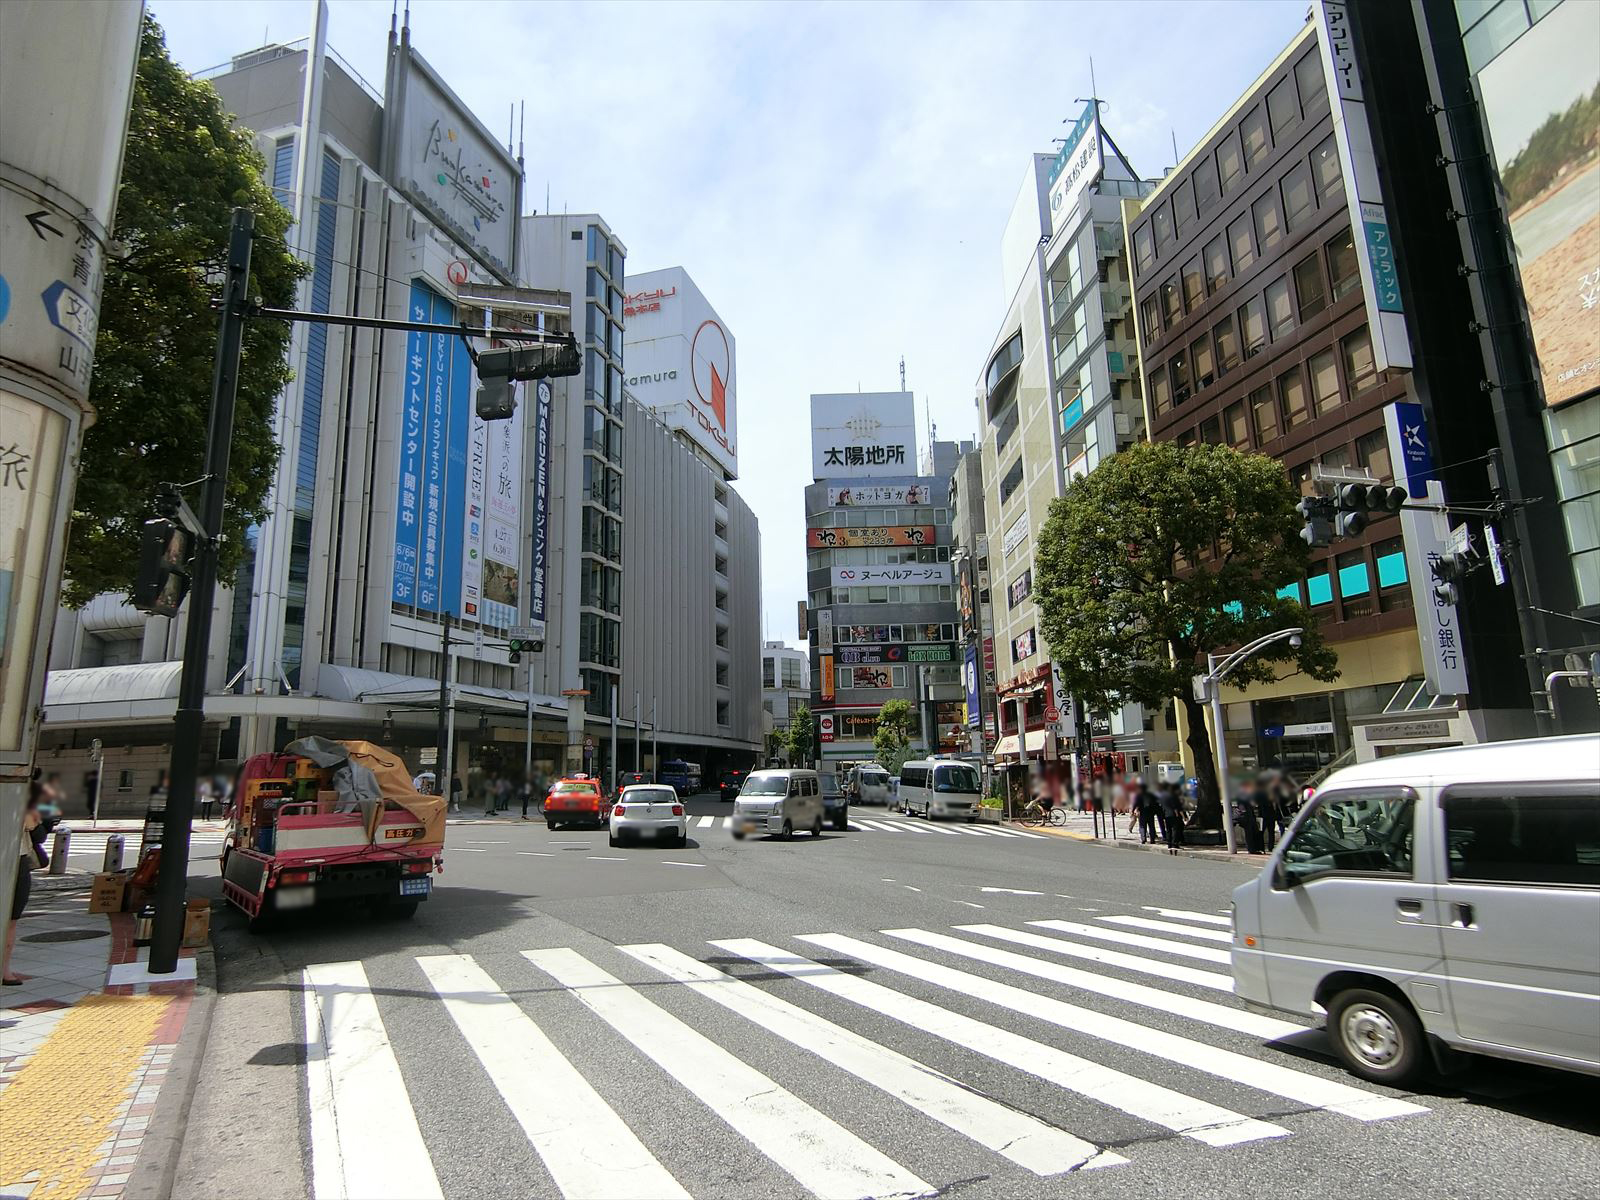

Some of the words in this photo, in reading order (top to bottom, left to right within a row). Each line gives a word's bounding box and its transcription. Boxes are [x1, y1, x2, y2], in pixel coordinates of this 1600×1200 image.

[1374, 230, 1396, 304] アフラック
[436, 328, 445, 372] OKYU
[688, 400, 735, 457] TOKYU
[824, 446, 905, 466] 太陽地所
[856, 490, 904, 501] ホットヨガ
[861, 570, 943, 581] ヌーベルアージュ
[396, 583, 410, 598] 3F
[421, 590, 435, 605] 6F
[386, 829, 414, 838] 高圧ガ
